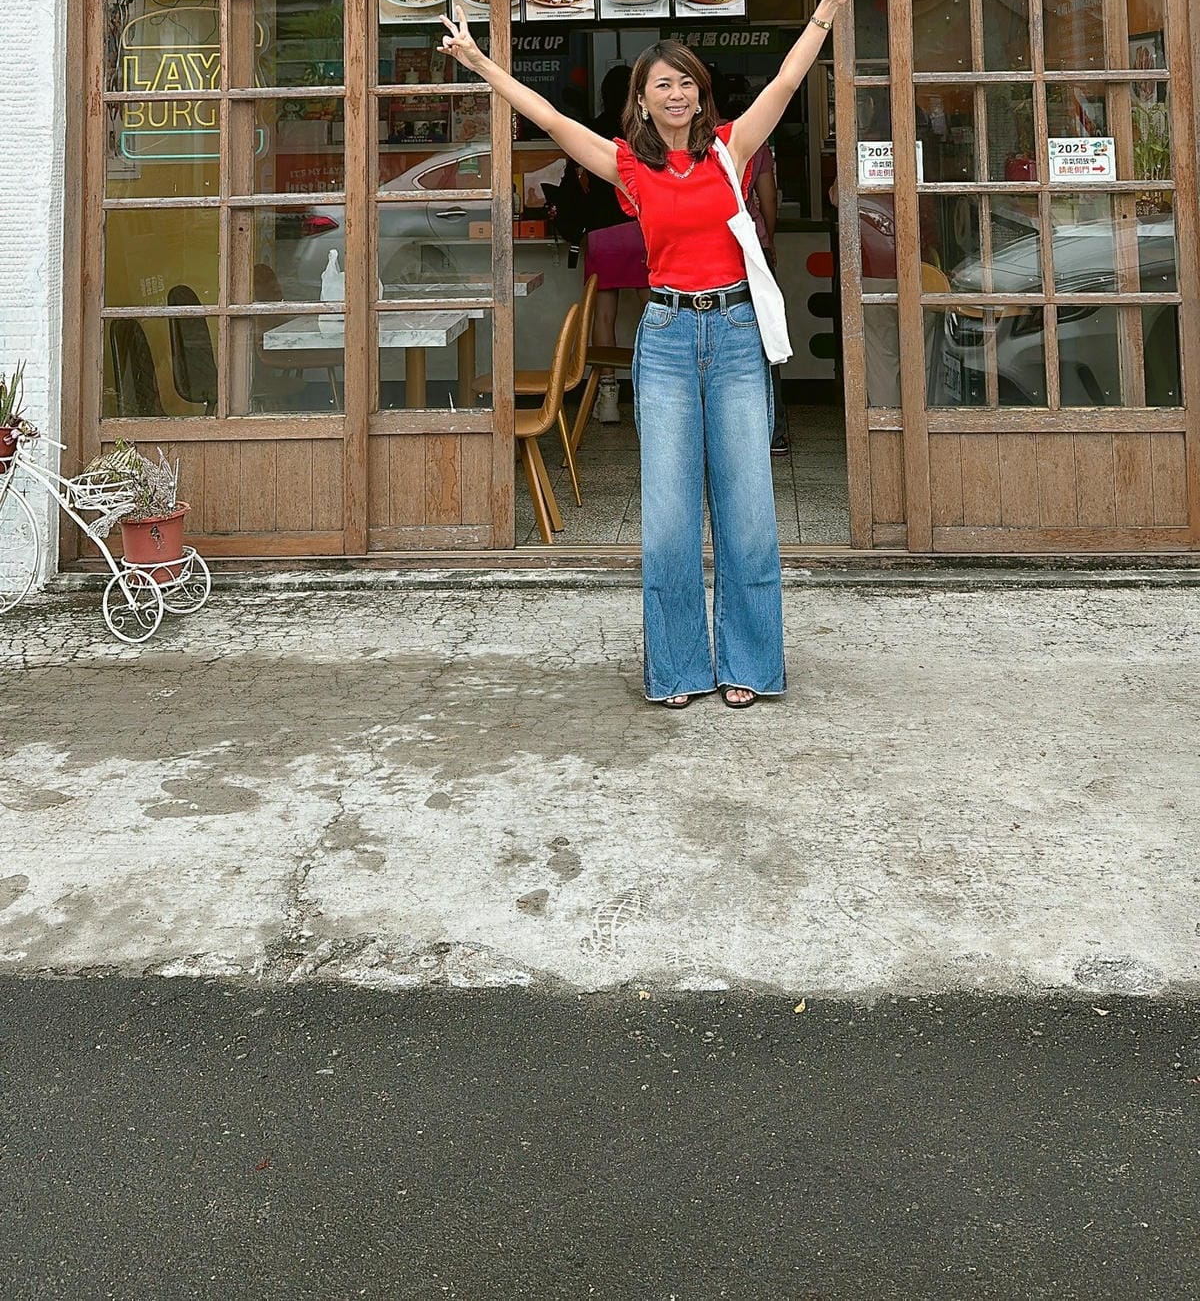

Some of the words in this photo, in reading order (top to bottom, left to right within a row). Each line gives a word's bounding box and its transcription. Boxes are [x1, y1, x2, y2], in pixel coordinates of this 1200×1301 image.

[511, 36, 541, 50] PICK
[544, 36, 564, 49] UP
[720, 32, 770, 46] ORDER
[513, 60, 560, 72] URGER
[1058, 144, 1087, 154] 2025
[871, 160, 894, 169] 冷氣開
[868, 169, 894, 177] 請走側
